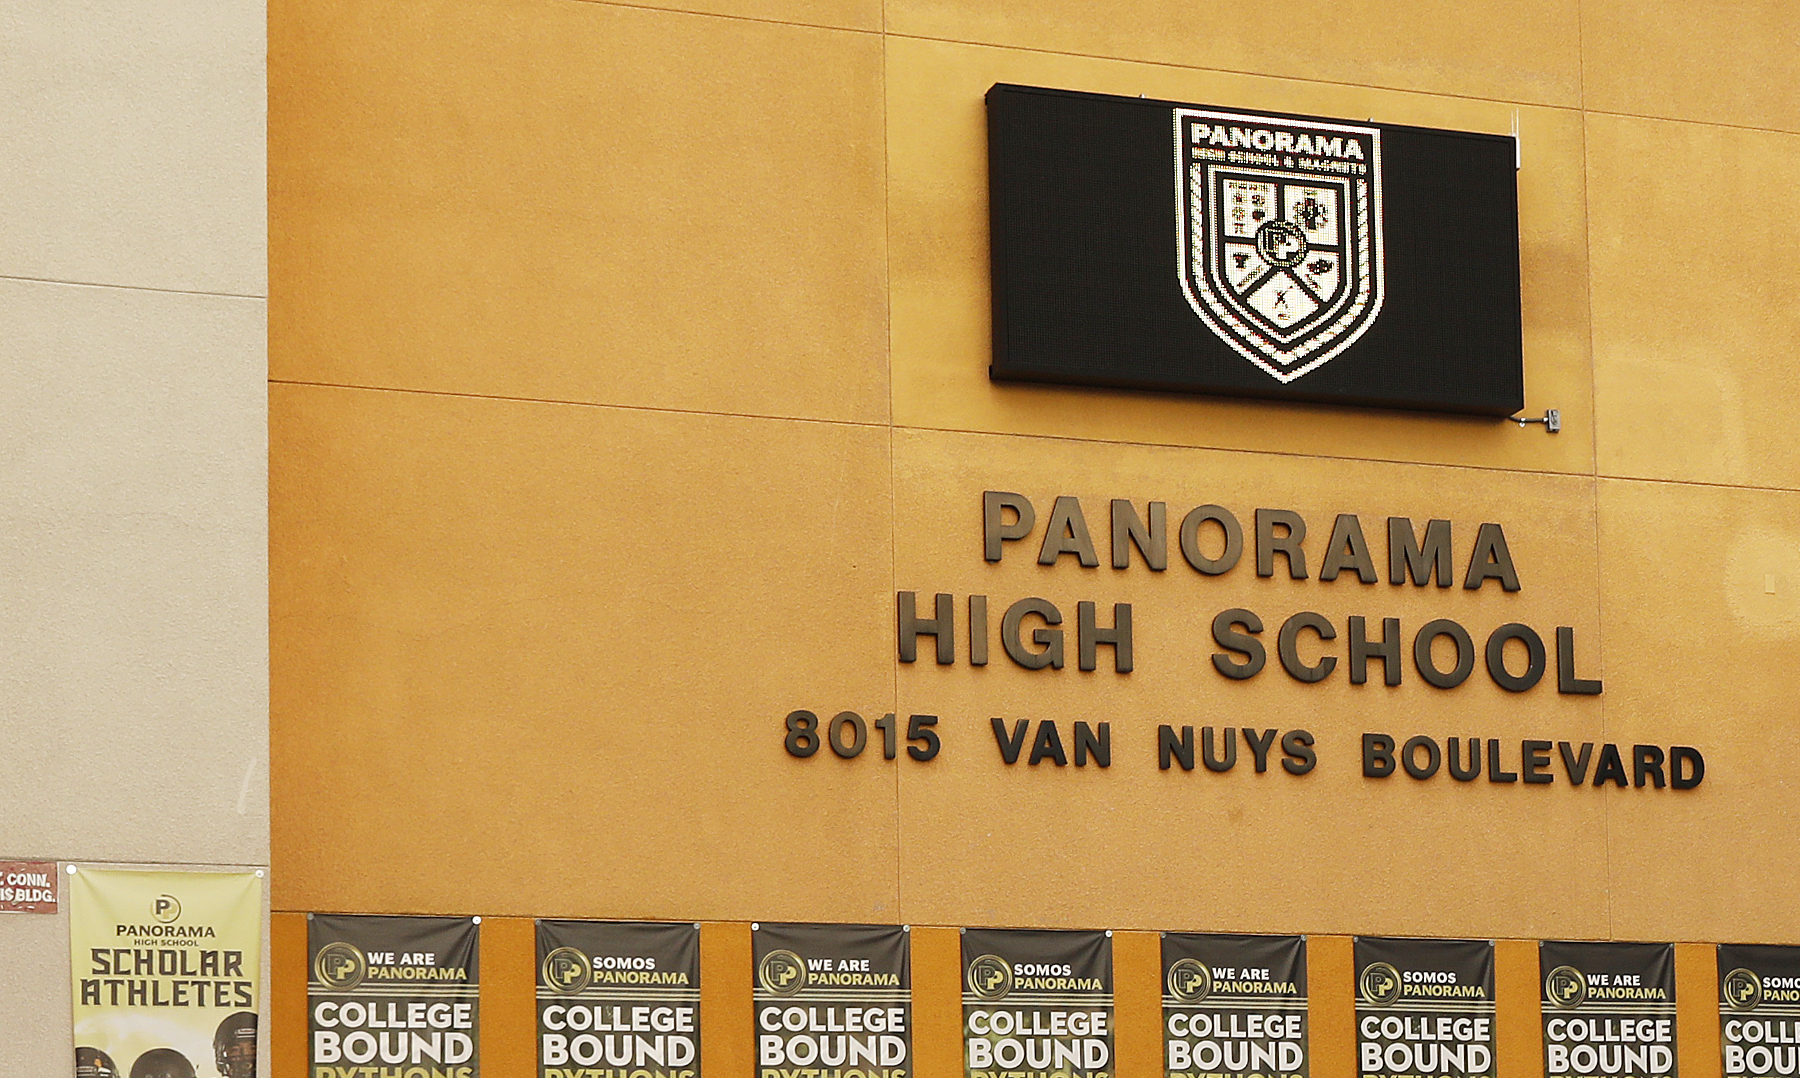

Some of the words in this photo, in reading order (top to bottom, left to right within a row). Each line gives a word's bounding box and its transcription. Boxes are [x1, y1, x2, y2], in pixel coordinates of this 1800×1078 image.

[1191, 122, 1365, 160] PANORAMA
[983, 490, 1521, 591] PANORAMA
[897, 591, 1133, 673] HIGH
[1211, 607, 1602, 694] SCHOOL
[784, 710, 940, 761] 8015
[991, 716, 1111, 767] VAN
[1158, 724, 1316, 776] NUYS
[1362, 732, 1705, 791] BOULEVARD
[7, 873, 51, 887] CONN.
[15, 888, 56, 902] BLDG.
[116, 925, 216, 938] PANORAMA
[161, 939, 199, 947] SCHOOL
[90, 948, 243, 977] SCHOLAR
[367, 952, 395, 965] WE
[400, 952, 435, 965] ARE
[593, 956, 655, 970] SOMOS
[807, 960, 833, 972] WE
[838, 959, 870, 972] ARE
[1014, 963, 1071, 976] SOMOS
[368, 966, 467, 980] PANORAMA
[593, 971, 689, 985] PANORAMA
[808, 973, 900, 986] PANORAMA
[1014, 977, 1103, 990] PANORAMA
[1212, 967, 1236, 980] WE
[1240, 968, 1269, 980] ARE
[1403, 971, 1456, 984] SOMOS
[1587, 974, 1609, 986] WE
[1613, 975, 1641, 987] ARE
[80, 979, 252, 1007] ATHLETES
[1212, 981, 1297, 994] PANORAMA
[1404, 985, 1485, 998] PANORAMA
[1588, 987, 1666, 999] PANORAMA
[314, 1002, 472, 1029] COLLEGE
[542, 1005, 694, 1032] COLLEGE
[759, 1006, 905, 1032] COLLEGE
[968, 1010, 1108, 1036] COLLEGE
[1168, 1013, 1302, 1039] COLLEGE
[1360, 1016, 1490, 1041] COLLEGE
[1547, 1019, 1672, 1043] COLLEGE
[314, 1031, 473, 1064] BOUND
[542, 1034, 695, 1067] BOUND
[760, 1035, 906, 1067] BOUND
[969, 1038, 1109, 1069] BOUND
[1168, 1040, 1303, 1072] BOUND
[1361, 1042, 1491, 1074] BOUND
[1548, 1044, 1673, 1074] BOUND
